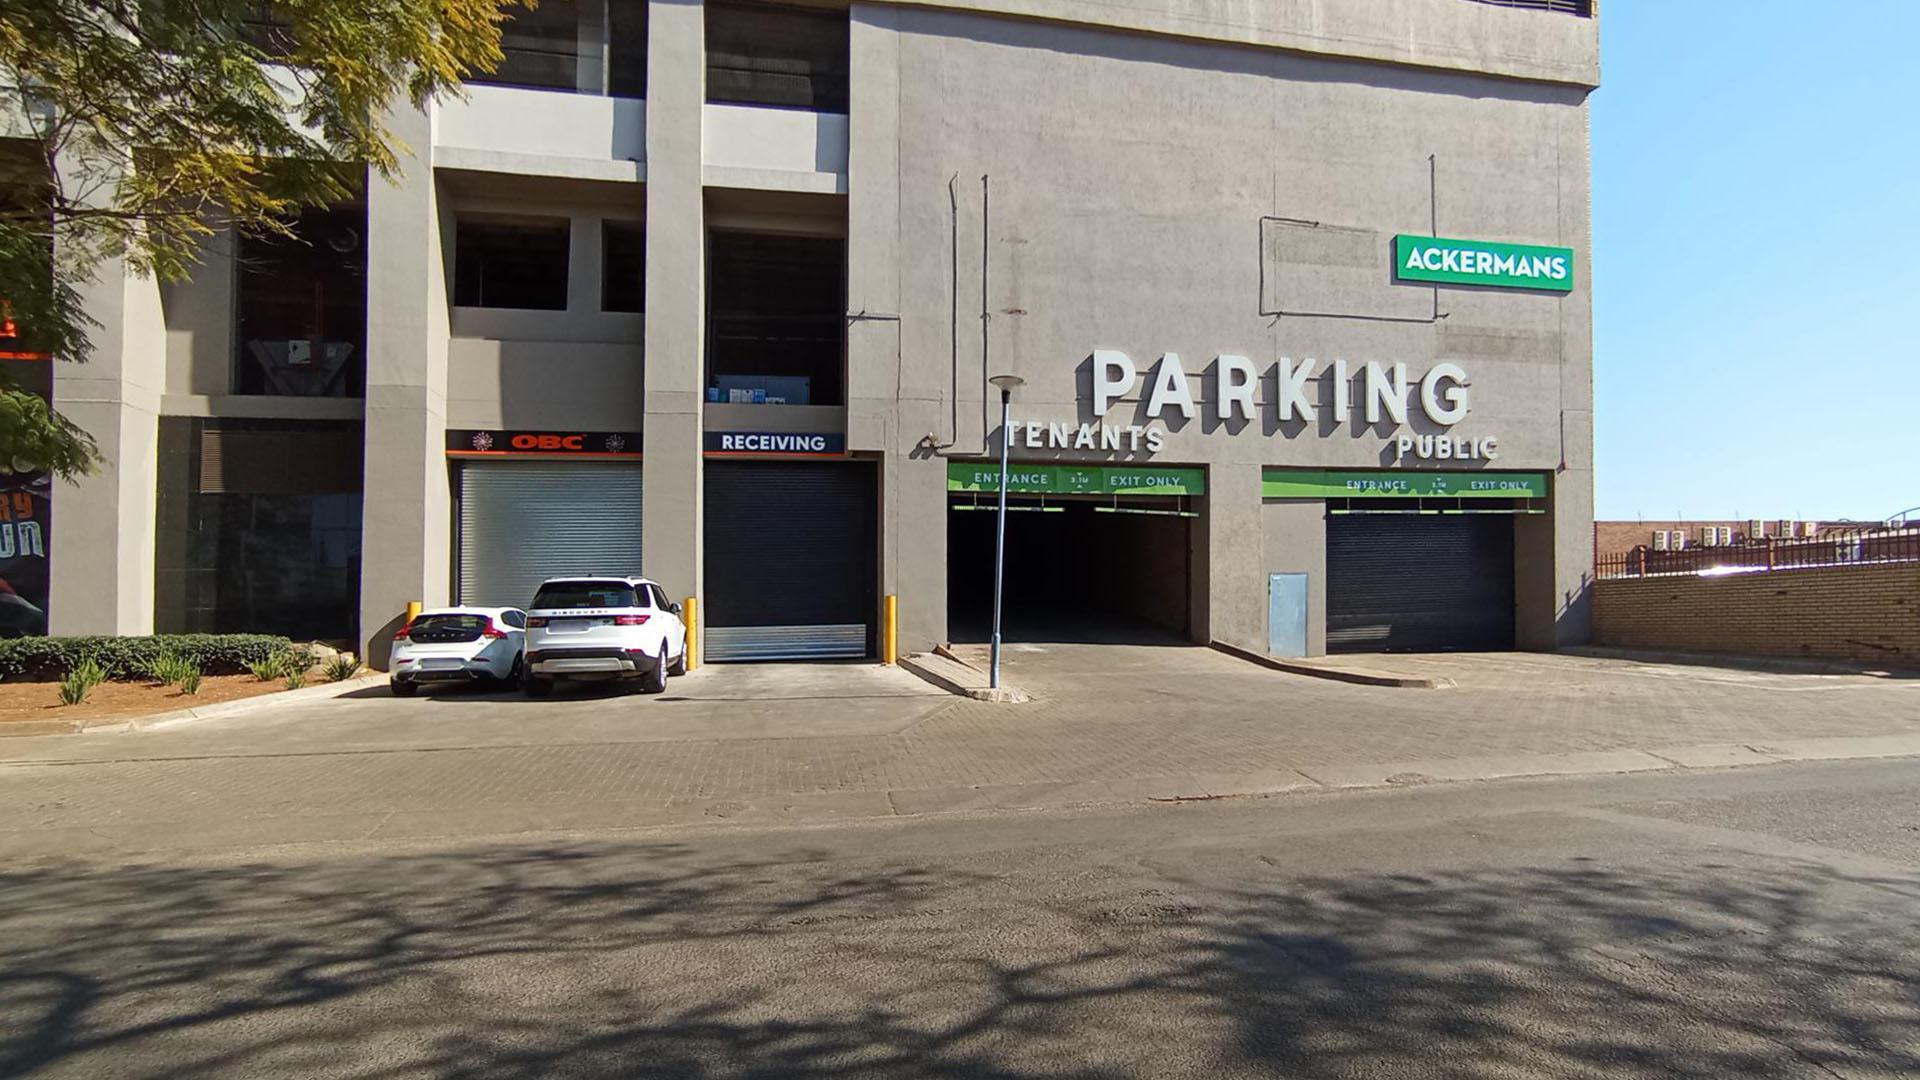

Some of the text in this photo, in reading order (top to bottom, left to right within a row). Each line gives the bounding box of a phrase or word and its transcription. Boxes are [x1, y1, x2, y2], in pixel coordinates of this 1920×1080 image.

[1406, 246, 1567, 280] ACKERMANS
[1092, 349, 1471, 426] PARKING
[511, 434, 583, 450] OBC
[722, 434, 826, 451] RECEIVING
[1007, 420, 1164, 452] TENANTS
[1397, 434, 1498, 461] PUBLIC
[1110, 475, 1181, 487] EXIT ONLY
[1346, 479, 1407, 490] ENTRANCE
[1471, 480, 1529, 490] EXIT ONLY
